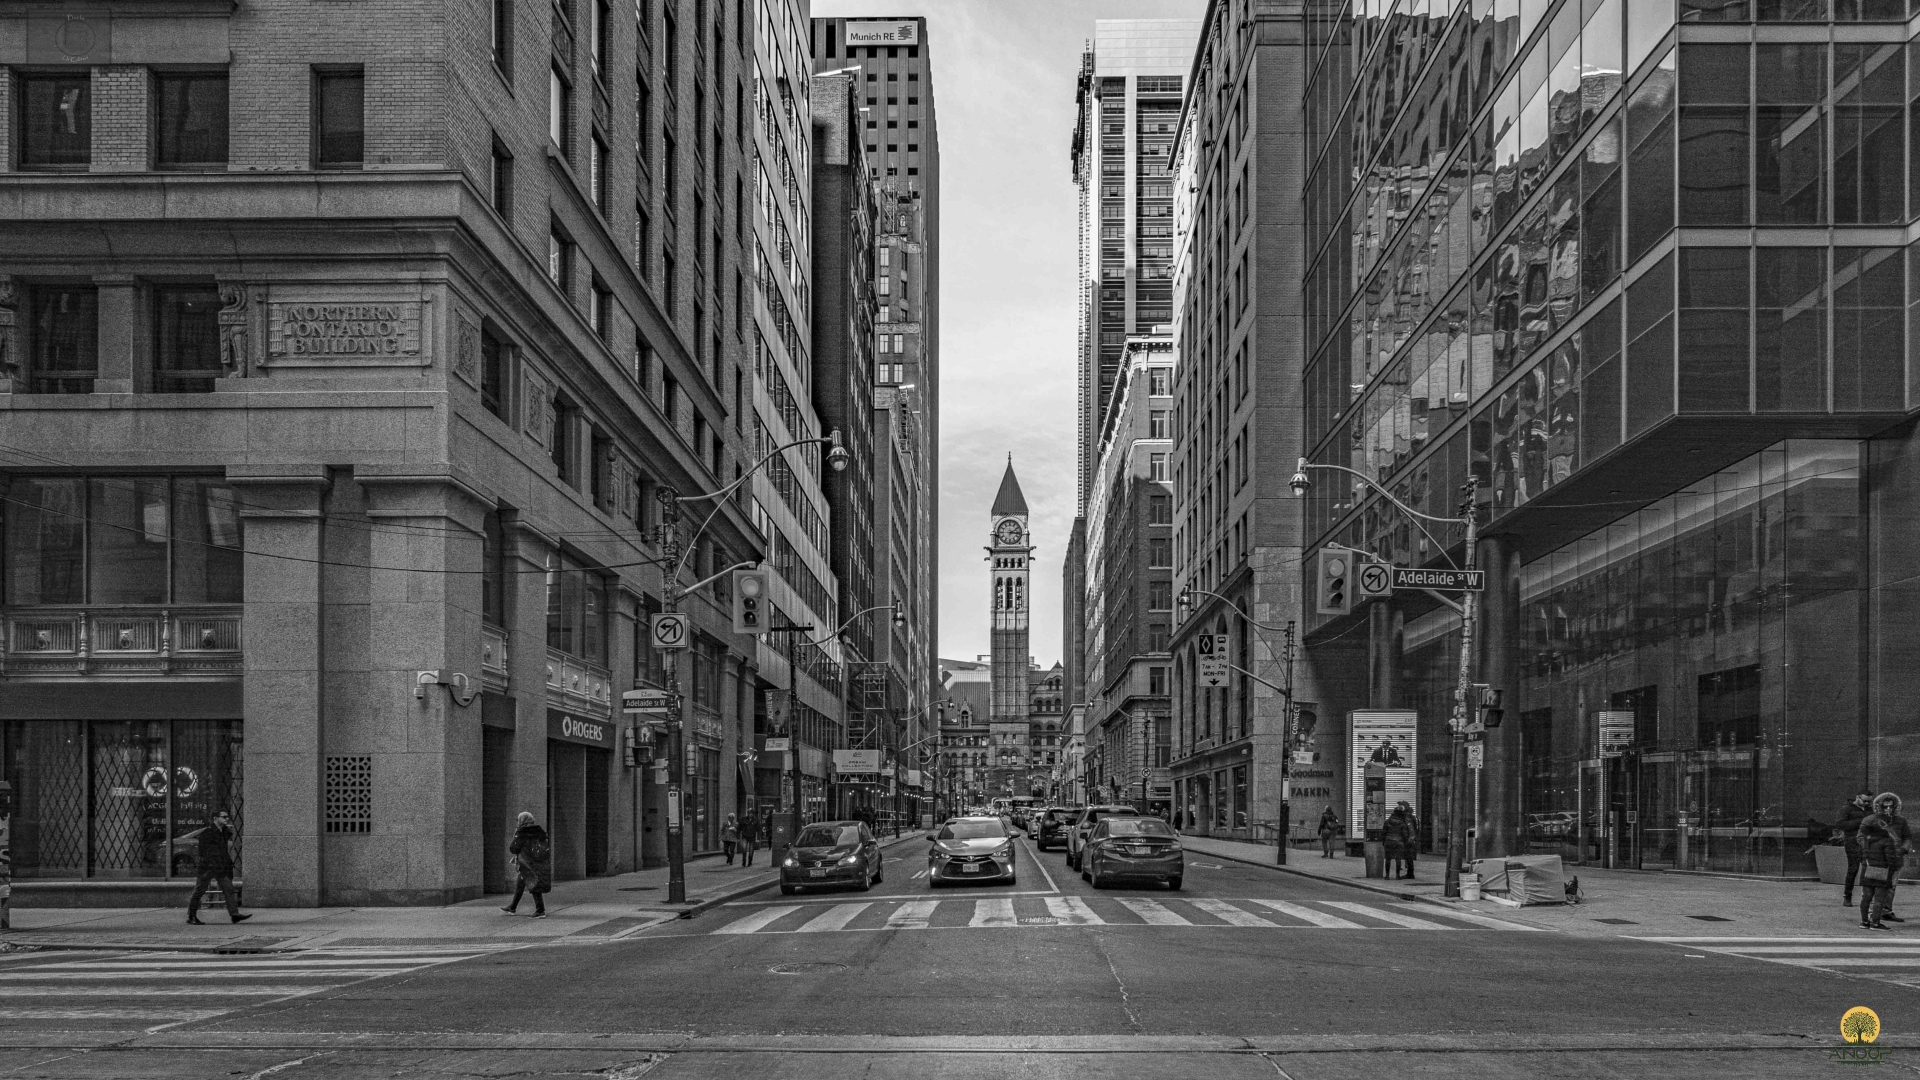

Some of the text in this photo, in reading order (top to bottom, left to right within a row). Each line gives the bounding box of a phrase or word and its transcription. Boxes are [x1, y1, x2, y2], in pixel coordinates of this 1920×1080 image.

[850, 33, 895, 41] Munich RE
[287, 306, 400, 322] NORTHERN
[296, 322, 393, 338] ONTARIO
[293, 337, 398, 354] BUILDING
[1397, 571, 1479, 586] Adelaide St W
[626, 699, 653, 707] Adelaide
[659, 699, 666, 707] W
[765, 691, 774, 719] ACHIEVE
[1291, 704, 1301, 735] CONNECT
[572, 720, 603, 741] ROGERS
[1290, 787, 1330, 797] FASKEN
